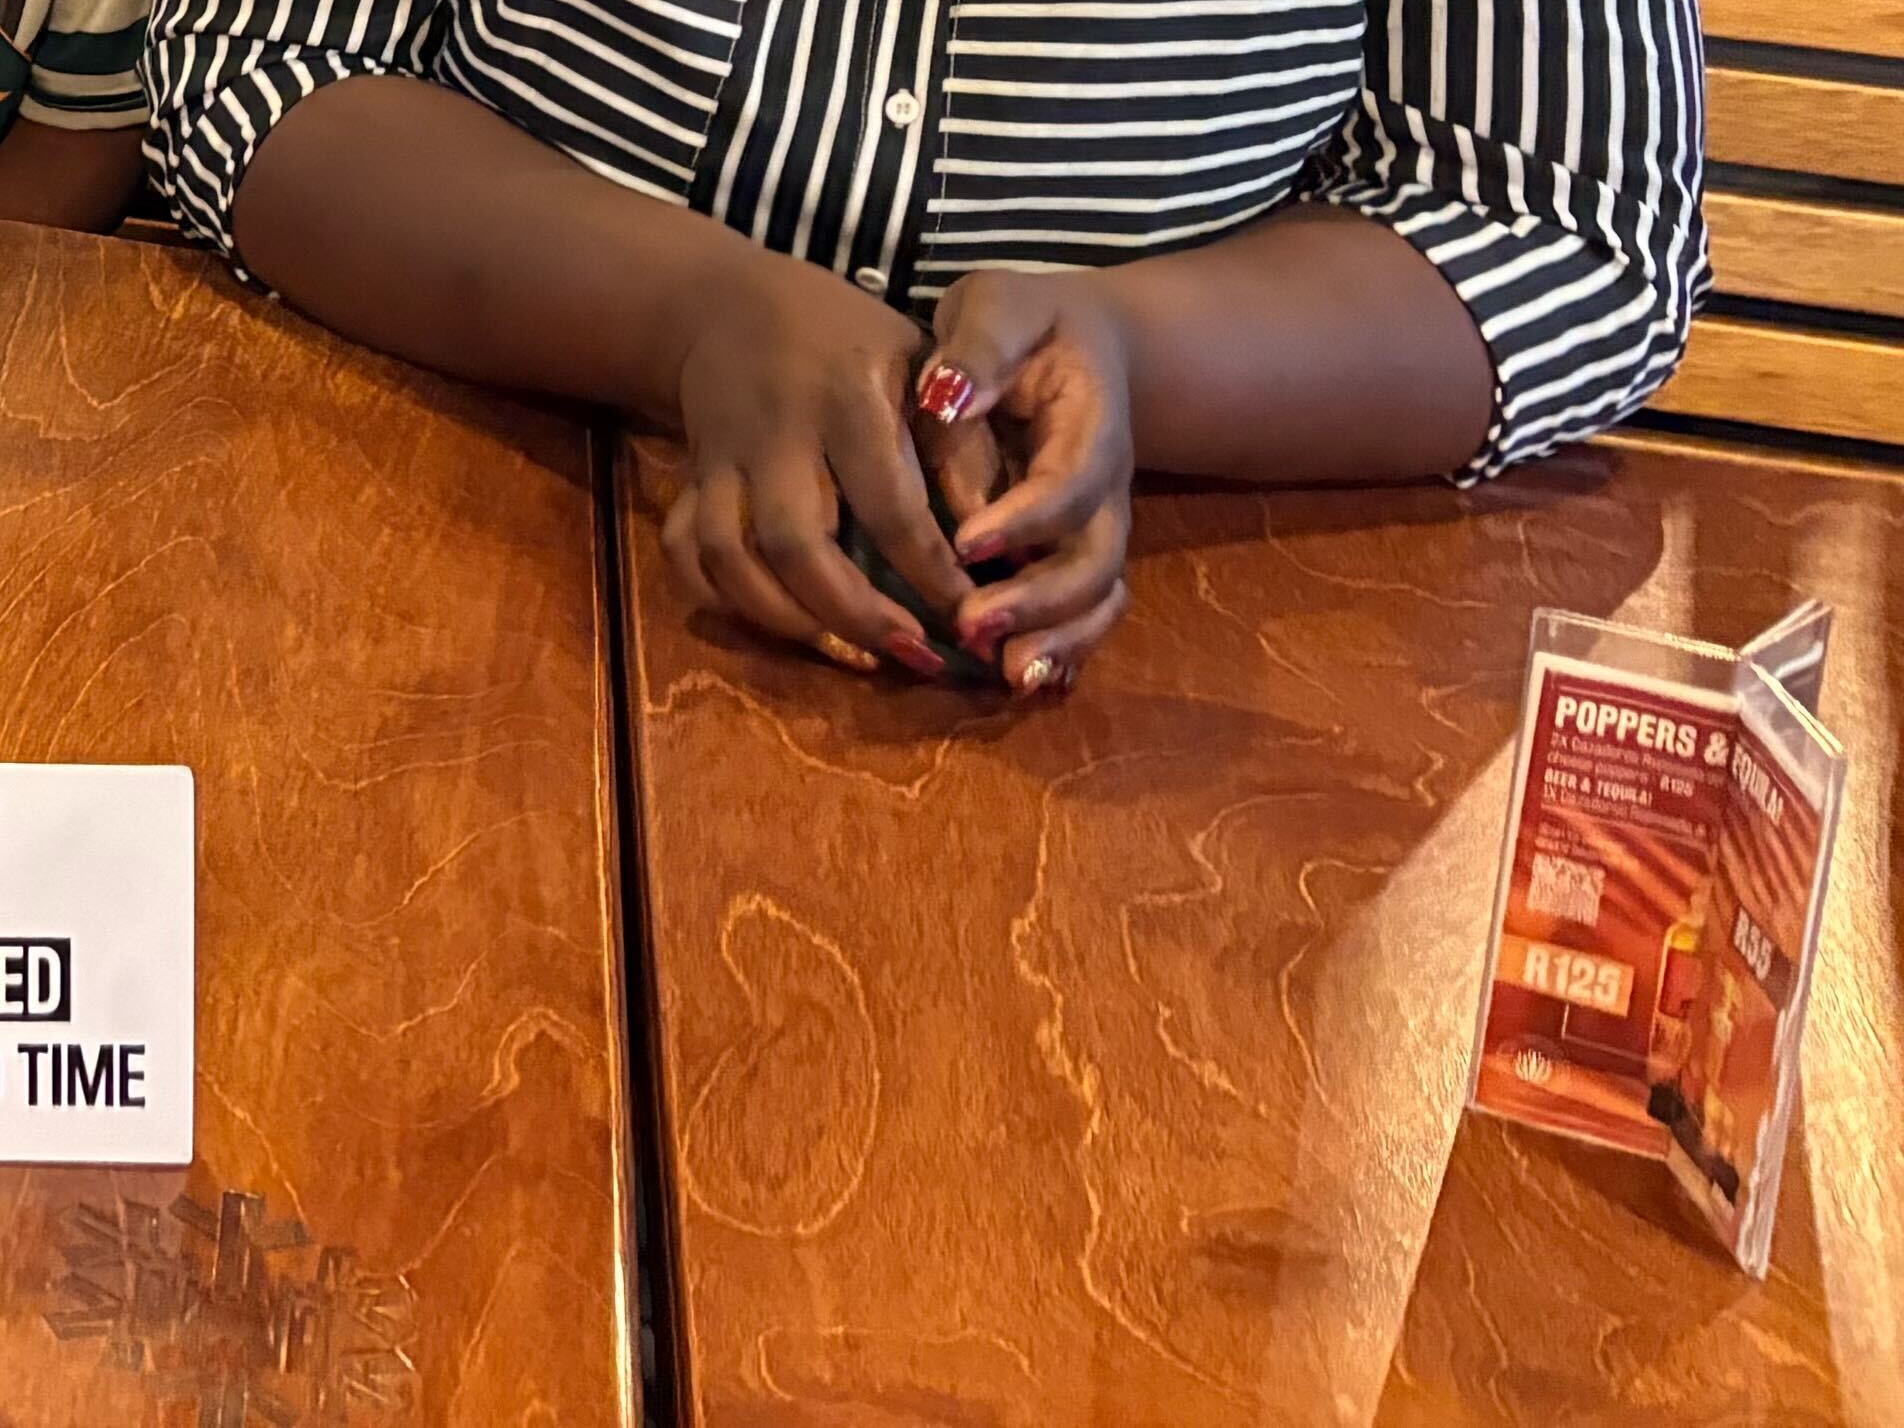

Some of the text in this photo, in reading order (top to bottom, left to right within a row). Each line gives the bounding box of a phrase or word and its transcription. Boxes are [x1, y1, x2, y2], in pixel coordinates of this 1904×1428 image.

[1554, 695, 1729, 767] POPPERS &
[1544, 768, 1577, 790] BEER
[1732, 742, 1785, 827] EQUILA!
[1523, 945, 1621, 1005] R125
[1734, 906, 1772, 981] R55
[17, 1043, 145, 1108] TIME
